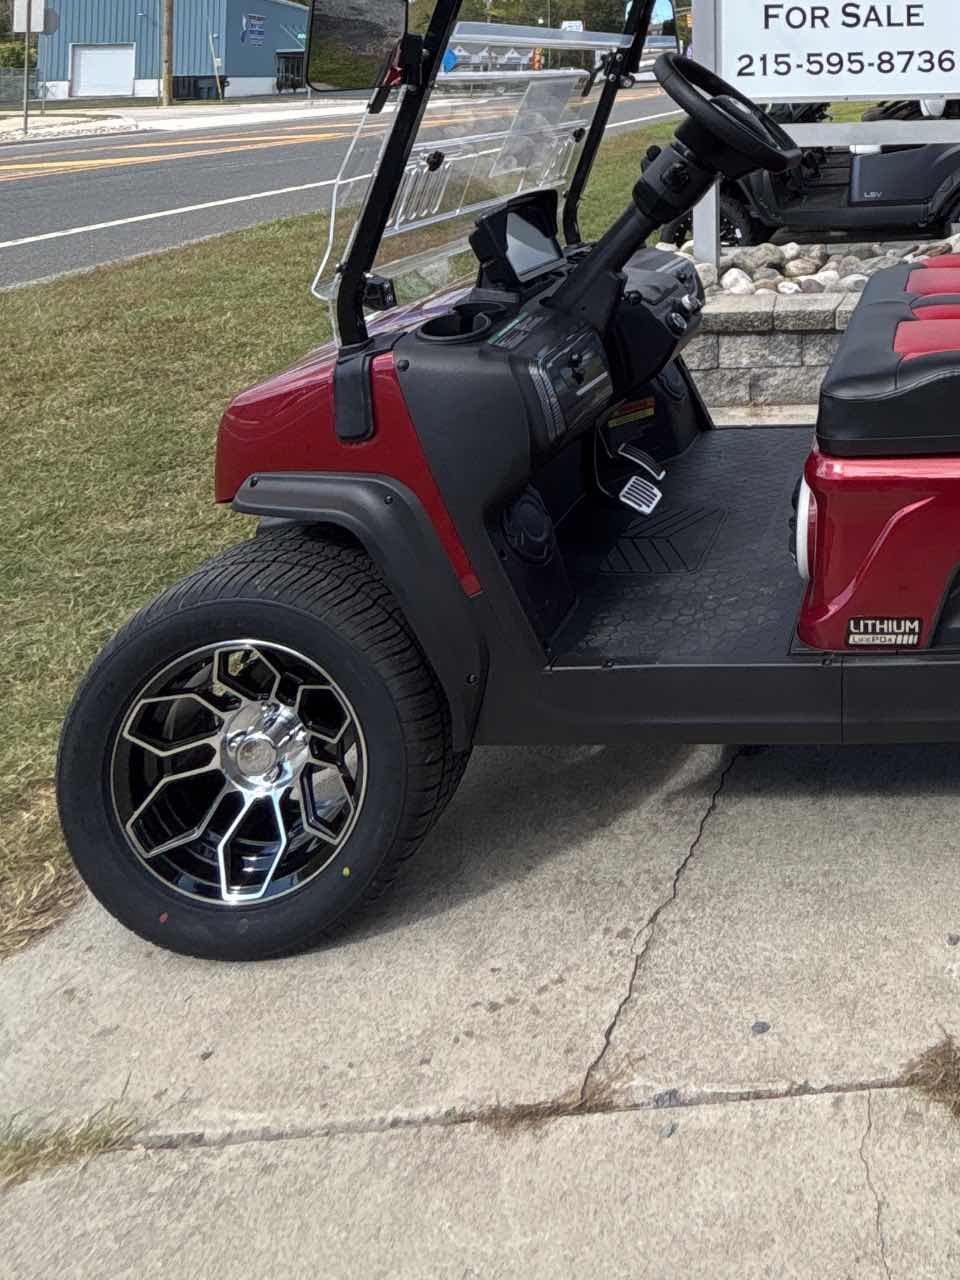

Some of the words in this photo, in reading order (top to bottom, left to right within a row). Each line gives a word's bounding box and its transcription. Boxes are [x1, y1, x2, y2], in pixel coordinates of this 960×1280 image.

[763, 3, 830, 30] FOR
[841, 2, 925, 29] SALE
[736, 49, 956, 77] 215-595-8736
[849, 619, 919, 633] LITHIUM
